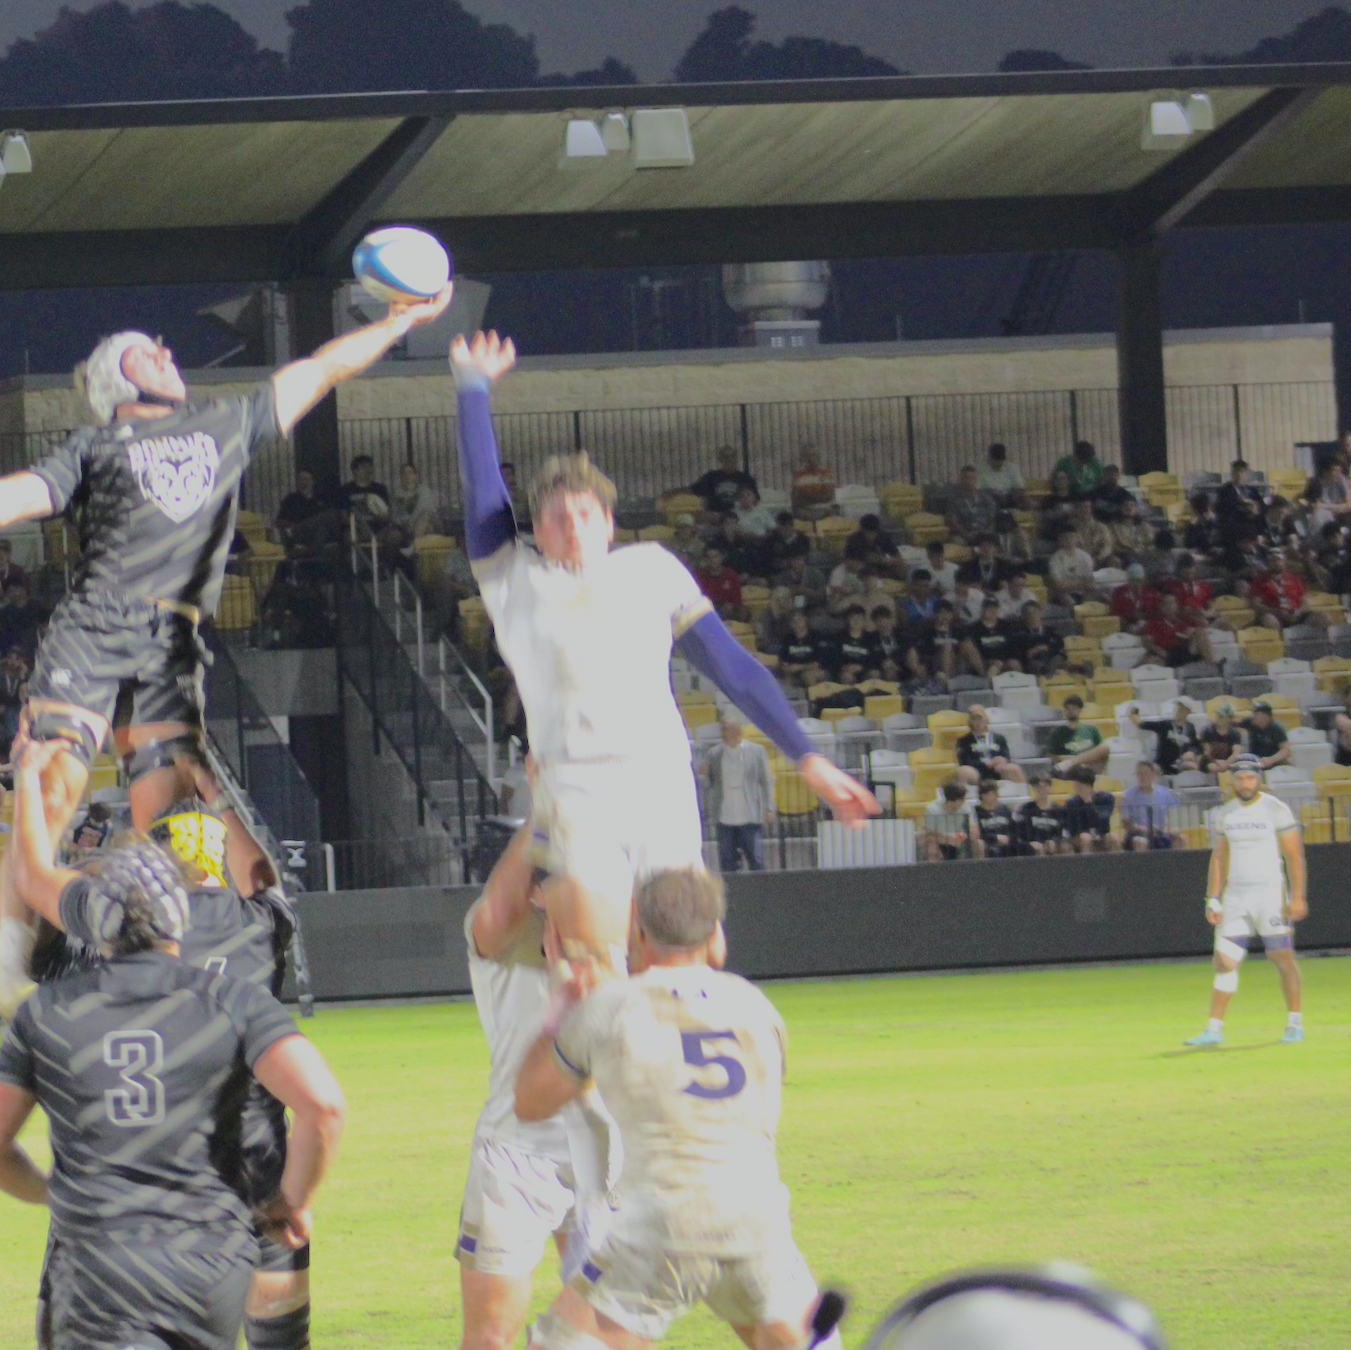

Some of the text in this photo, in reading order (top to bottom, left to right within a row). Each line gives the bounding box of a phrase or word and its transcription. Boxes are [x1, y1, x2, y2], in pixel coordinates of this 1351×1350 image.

[1225, 822, 1267, 831] QUEENS
[103, 1029, 166, 1127] 3
[679, 1029, 747, 1099] 5
